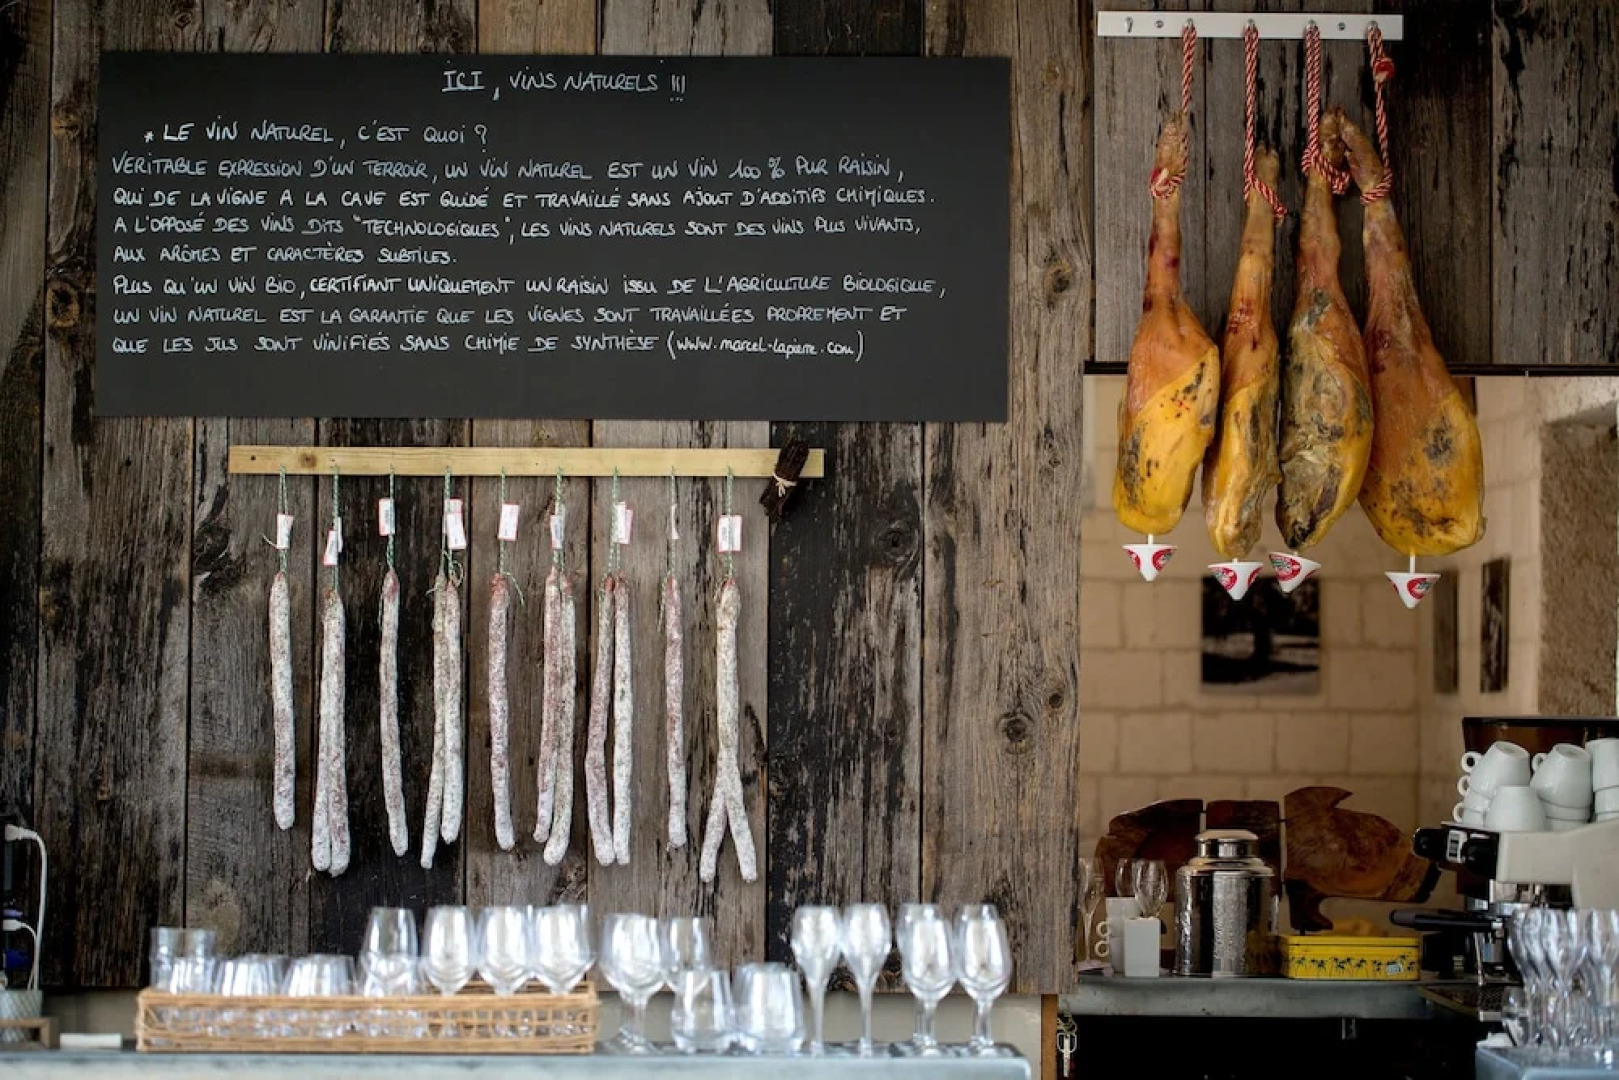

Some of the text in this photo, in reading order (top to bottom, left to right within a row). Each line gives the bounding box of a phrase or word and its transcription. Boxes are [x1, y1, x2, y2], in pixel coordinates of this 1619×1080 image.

[509, 66, 557, 90] VINS
[563, 72, 658, 92] NATURELS
[163, 122, 195, 142] LE
[205, 115, 238, 142] VIN
[357, 119, 410, 142] C'EST
[218, 158, 302, 179] EXPRESSION
[310, 156, 354, 178] D'UN
[444, 161, 469, 179] UN
[480, 157, 509, 178] VIN
[517, 159, 593, 180] NATUREL
[607, 161, 644, 179] EST
[651, 160, 679, 180] UN
[687, 156, 718, 178] VIN
[728, 159, 762, 179] 100
[768, 156, 786, 179] %
[795, 155, 829, 176] PUR
[113, 187, 145, 206] QUI
[148, 190, 181, 207] DE
[190, 192, 211, 207] LA
[216, 187, 268, 205] VIGNE
[279, 188, 294, 206] A
[305, 191, 328, 206] LA
[341, 190, 387, 207] CAVE
[399, 190, 431, 207] EST
[502, 192, 529, 208] ET
[534, 186, 622, 208] TRAVAILLÉ
[627, 192, 671, 208] SANS
[682, 186, 734, 207] AJOUT
[114, 216, 127, 233] A
[212, 217, 250, 233] DES
[260, 211, 295, 233] VINS
[301, 218, 344, 234] DITS
[520, 222, 551, 238] LES
[559, 217, 593, 237] VINS
[598, 221, 676, 237] NATURELS
[684, 220, 728, 236] SONT
[734, 221, 767, 236] DES
[771, 216, 805, 234] VINS
[814, 216, 846, 233] PLUS
[113, 245, 146, 263] AUX
[159, 243, 221, 263] ARÔMES
[230, 246, 258, 263] ET
[266, 241, 365, 263] CARACTÈRES
[112, 274, 153, 295] PLUS
[227, 276, 256, 294] VIN
[309, 273, 402, 294] CERTIFIANT
[407, 273, 516, 296] UNIQUEMENT
[525, 276, 553, 293] UN
[556, 274, 609, 296] RAISIN
[622, 274, 658, 294] ISSU
[666, 278, 697, 295] DE
[113, 302, 908, 325] UN VIN NATUREL EST LA GARANTIE QUE LES VIGNES SONT TRAVAILLÉES PROPREMENT ET
[112, 337, 149, 354] QUE
[163, 337, 194, 353] LES
[204, 336, 239, 352] JUS
[253, 335, 304, 352] SONT
[313, 331, 391, 352] VINIFIÉS
[399, 334, 450, 352] SANS
[464, 332, 521, 355] CHIMIE
[527, 336, 559, 352] DE
[570, 328, 660, 351] SYNTHÈSE
